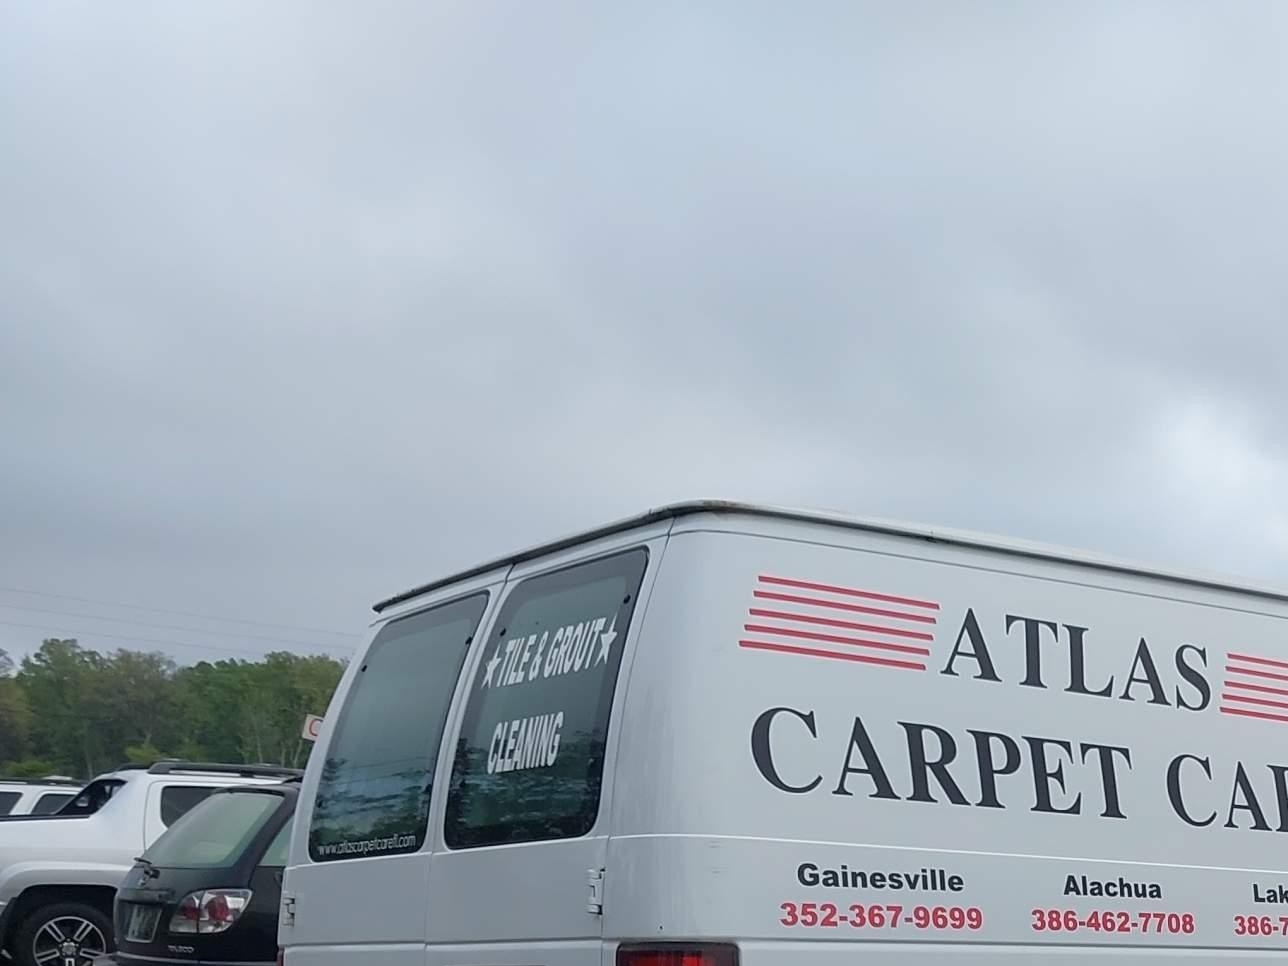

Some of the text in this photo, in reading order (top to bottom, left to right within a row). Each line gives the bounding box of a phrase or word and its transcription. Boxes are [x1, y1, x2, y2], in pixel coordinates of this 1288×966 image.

[497, 617, 606, 688] TILE & GROUT
[939, 606, 1213, 712] ATLAS
[487, 711, 563, 775] CLEANING
[750, 706, 1132, 820] CARPET
[797, 862, 964, 892] Gainesville
[1063, 874, 1162, 900] Alachua
[780, 902, 984, 931] 352-367-9699
[1032, 908, 1196, 935] 386-462-7708
